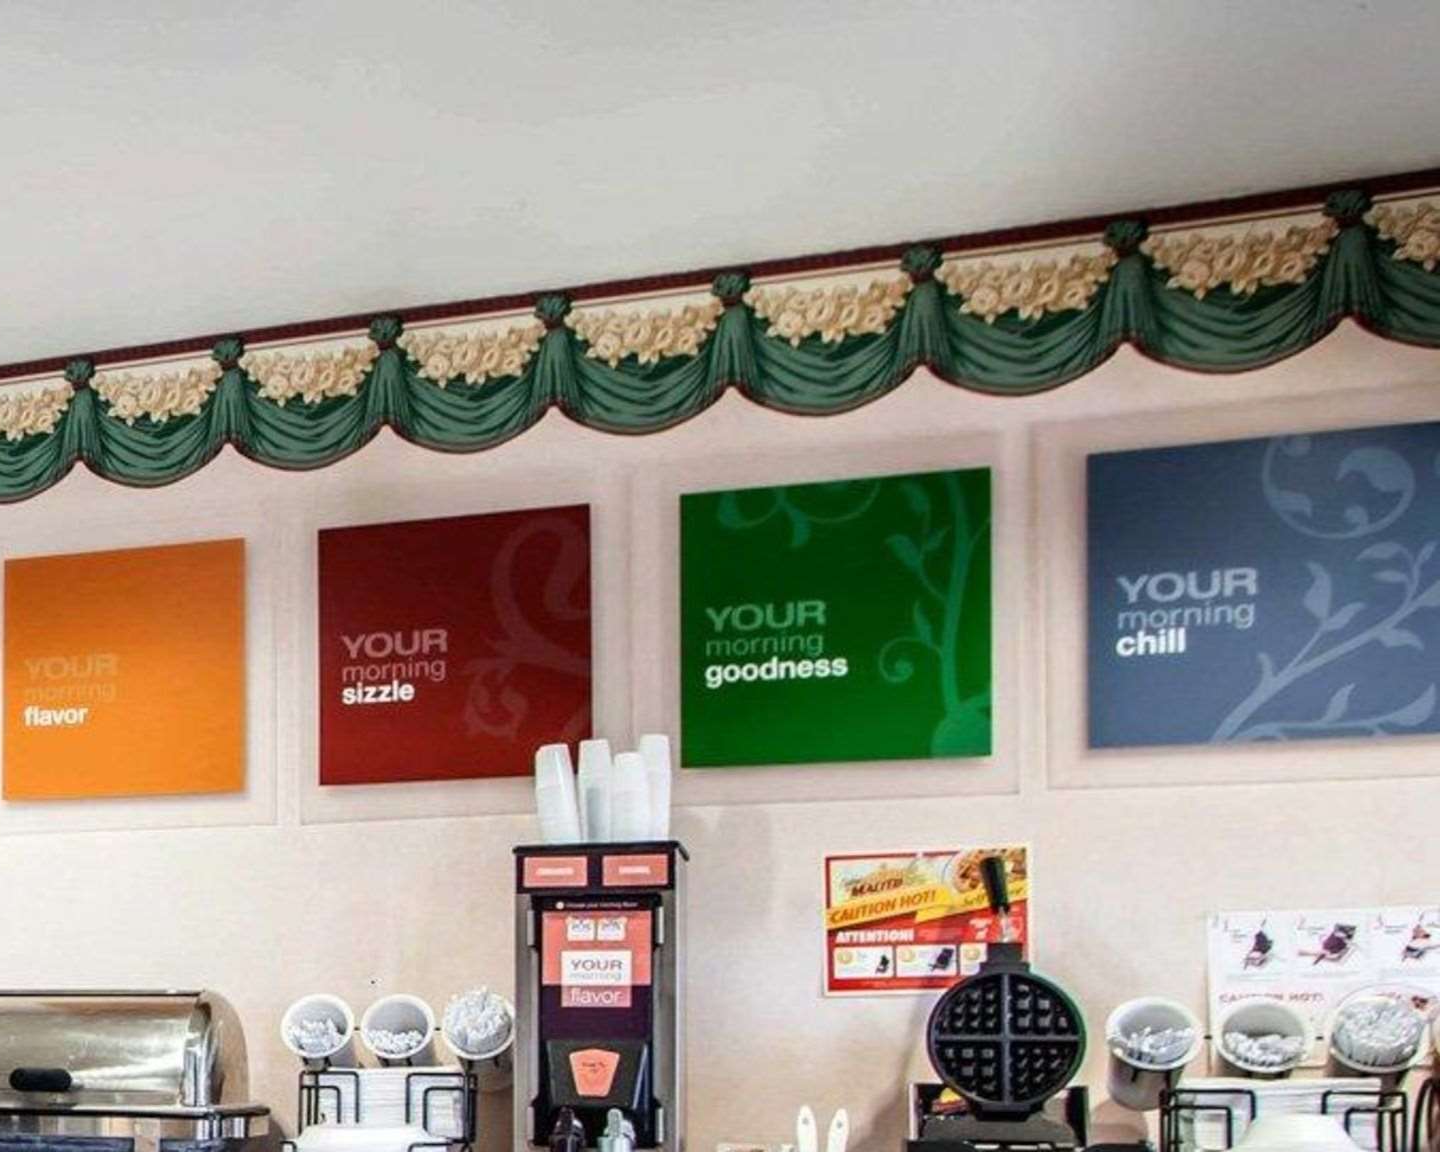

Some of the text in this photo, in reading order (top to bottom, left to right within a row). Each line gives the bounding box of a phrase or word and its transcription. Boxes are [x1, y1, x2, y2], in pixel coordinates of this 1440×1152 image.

[1116, 567, 1257, 604] YOUR
[705, 600, 826, 632] YOUR
[1117, 602, 1256, 629] morning
[341, 629, 447, 659] YOUR
[706, 632, 823, 658] morning
[1116, 627, 1186, 657] chill
[23, 653, 119, 680] YOUR
[342, 658, 446, 682] morning
[705, 656, 848, 689] goodness
[341, 680, 415, 704] sizzle
[24, 705, 88, 726] flavor
[830, 899, 898, 924] CAUTION
[570, 959, 623, 971] YOUR
[571, 988, 621, 1004] flavor
